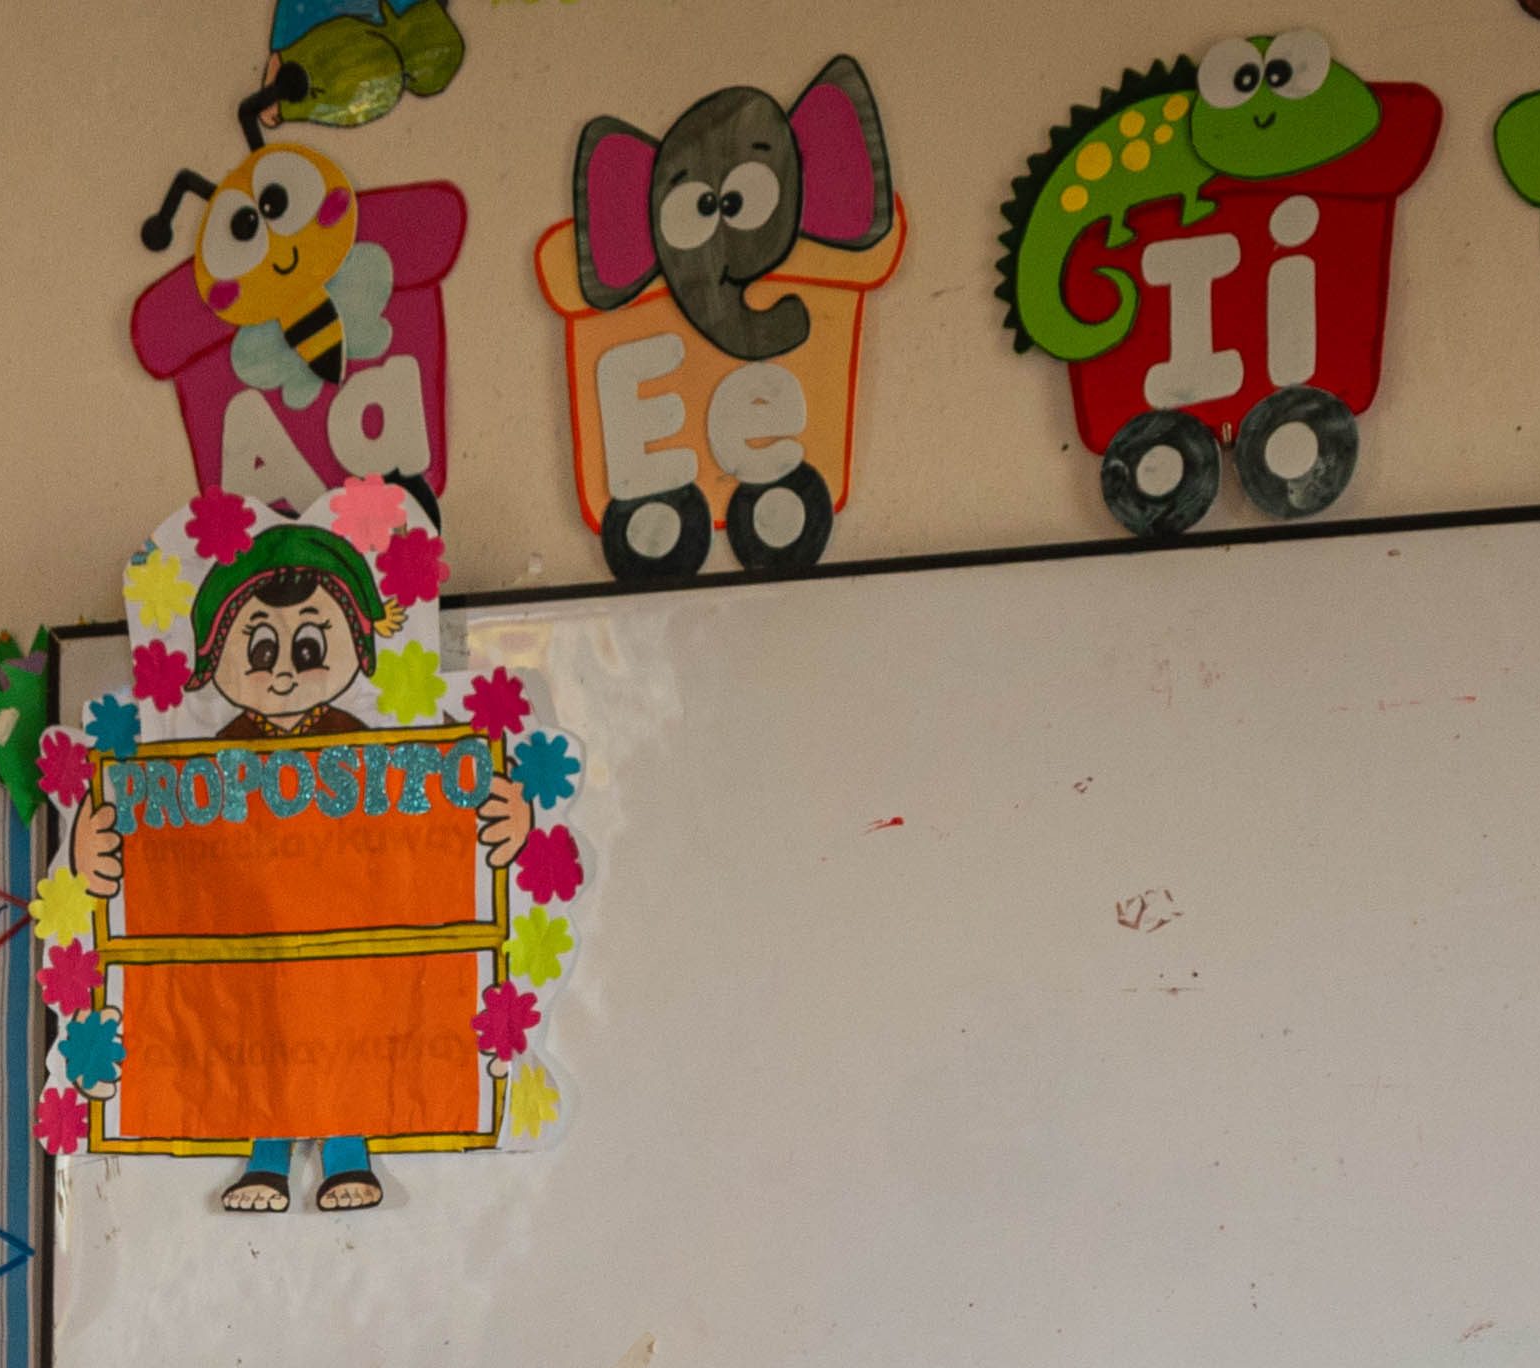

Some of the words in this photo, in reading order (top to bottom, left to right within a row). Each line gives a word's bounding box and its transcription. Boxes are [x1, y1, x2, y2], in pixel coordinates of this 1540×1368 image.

[1140, 194, 1320, 408] Ii
[595, 333, 806, 501] Ee
[107, 738, 493, 834] PROPOSITO
